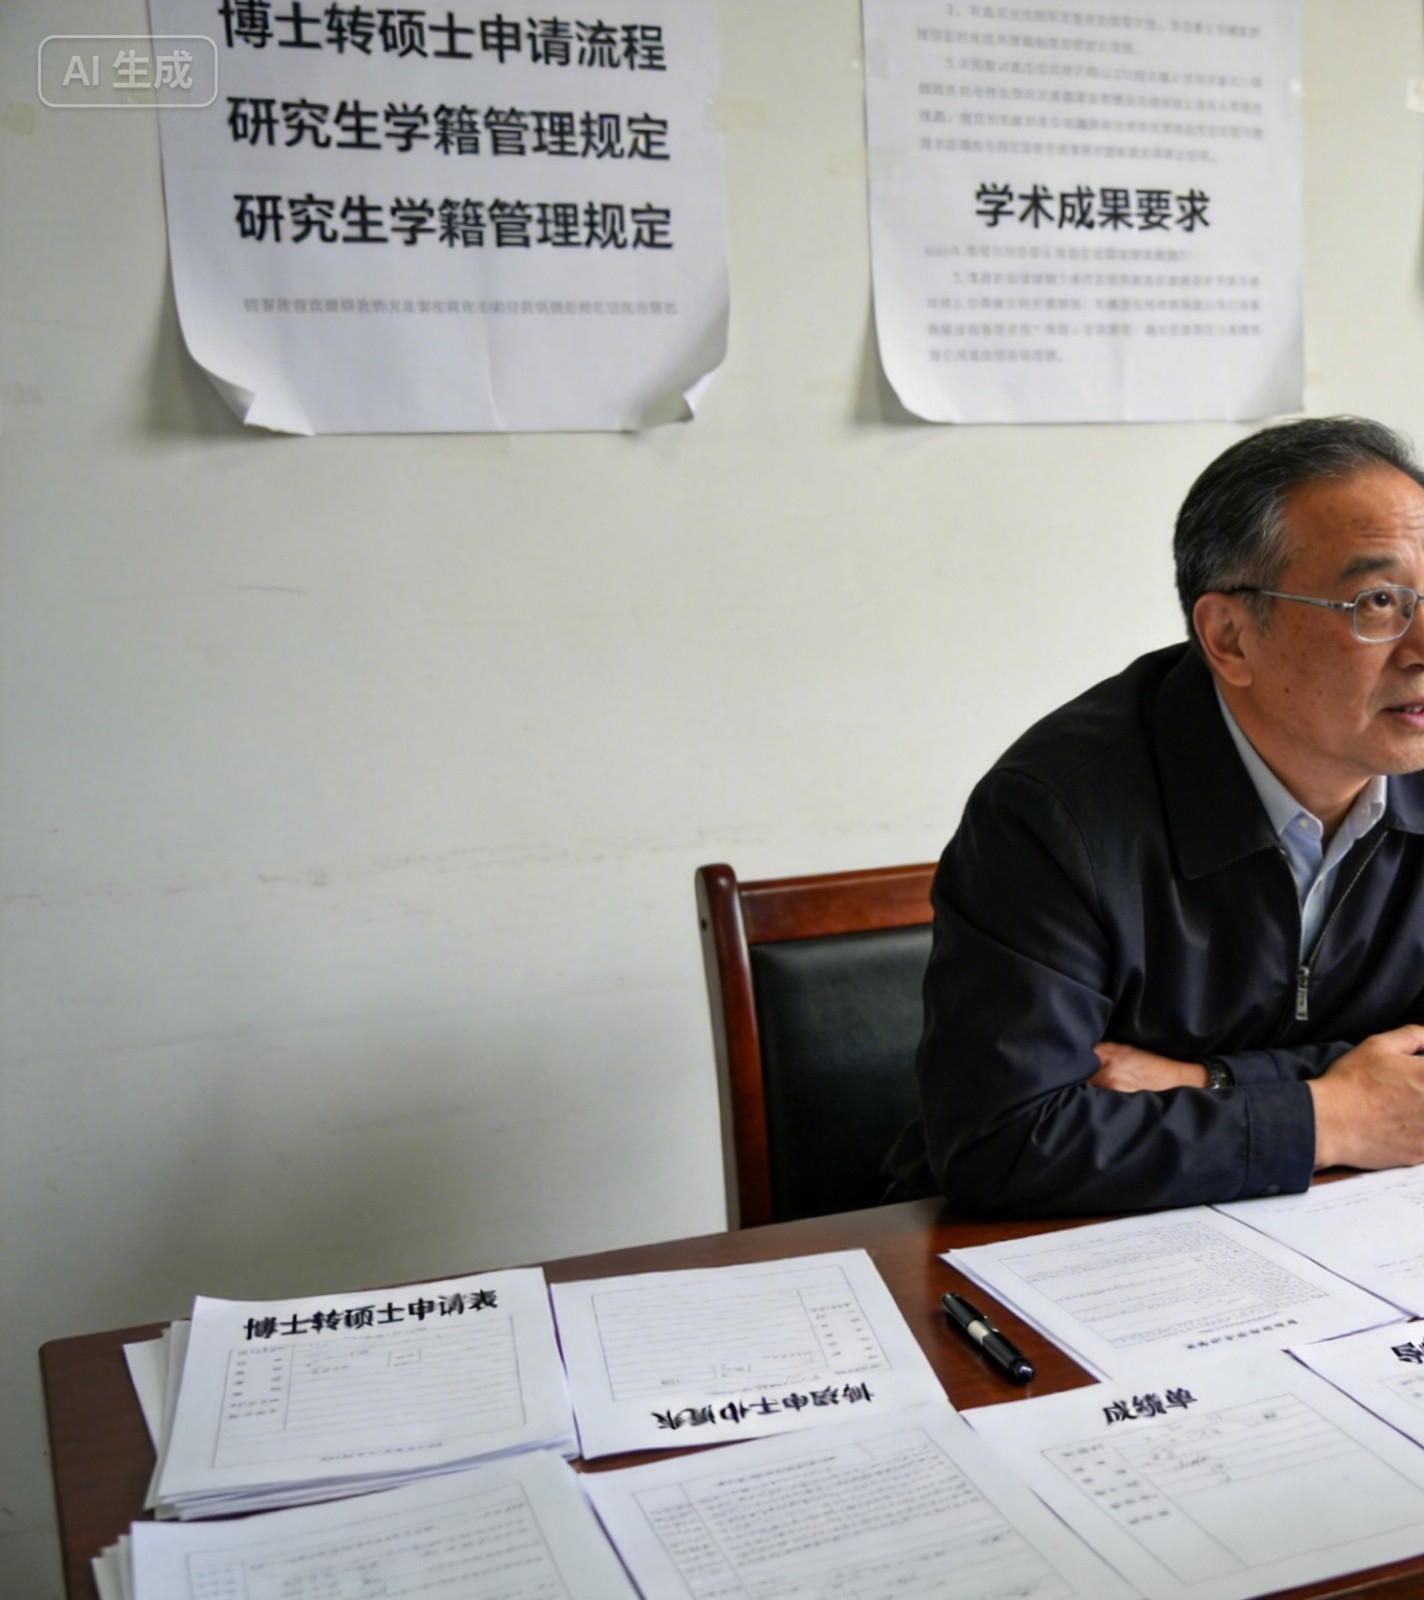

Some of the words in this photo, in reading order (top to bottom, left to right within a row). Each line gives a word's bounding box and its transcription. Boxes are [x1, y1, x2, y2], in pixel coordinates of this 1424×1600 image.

[218, 0, 668, 71] 博士转硕士申请流程
[226, 96, 671, 161] 研究生学籍管理规定
[233, 192, 674, 250] 研究生学籍管理规定
[974, 183, 1211, 232] 学术成果要求
